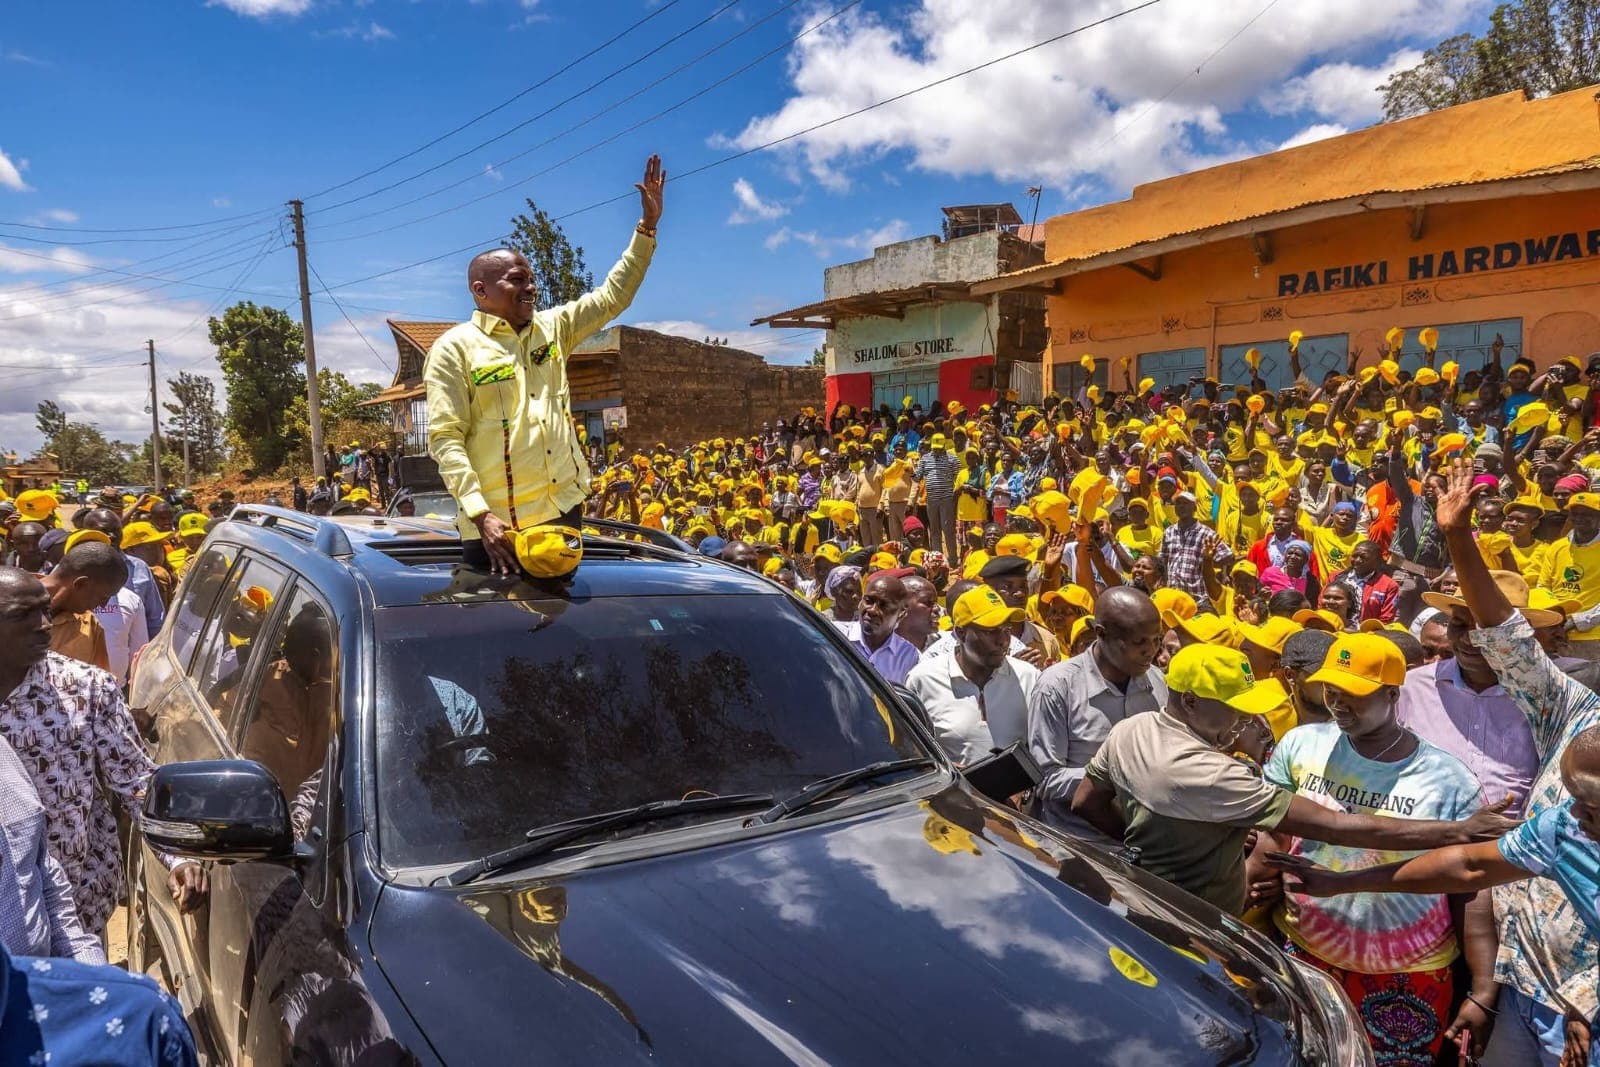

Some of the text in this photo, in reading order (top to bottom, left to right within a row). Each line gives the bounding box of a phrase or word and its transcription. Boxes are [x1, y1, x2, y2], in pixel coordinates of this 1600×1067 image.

[1278, 260, 1388, 297] RAFIKI
[854, 337, 955, 363] SHALOM STORE
[1300, 772, 1416, 816] NEW ORLEANS
